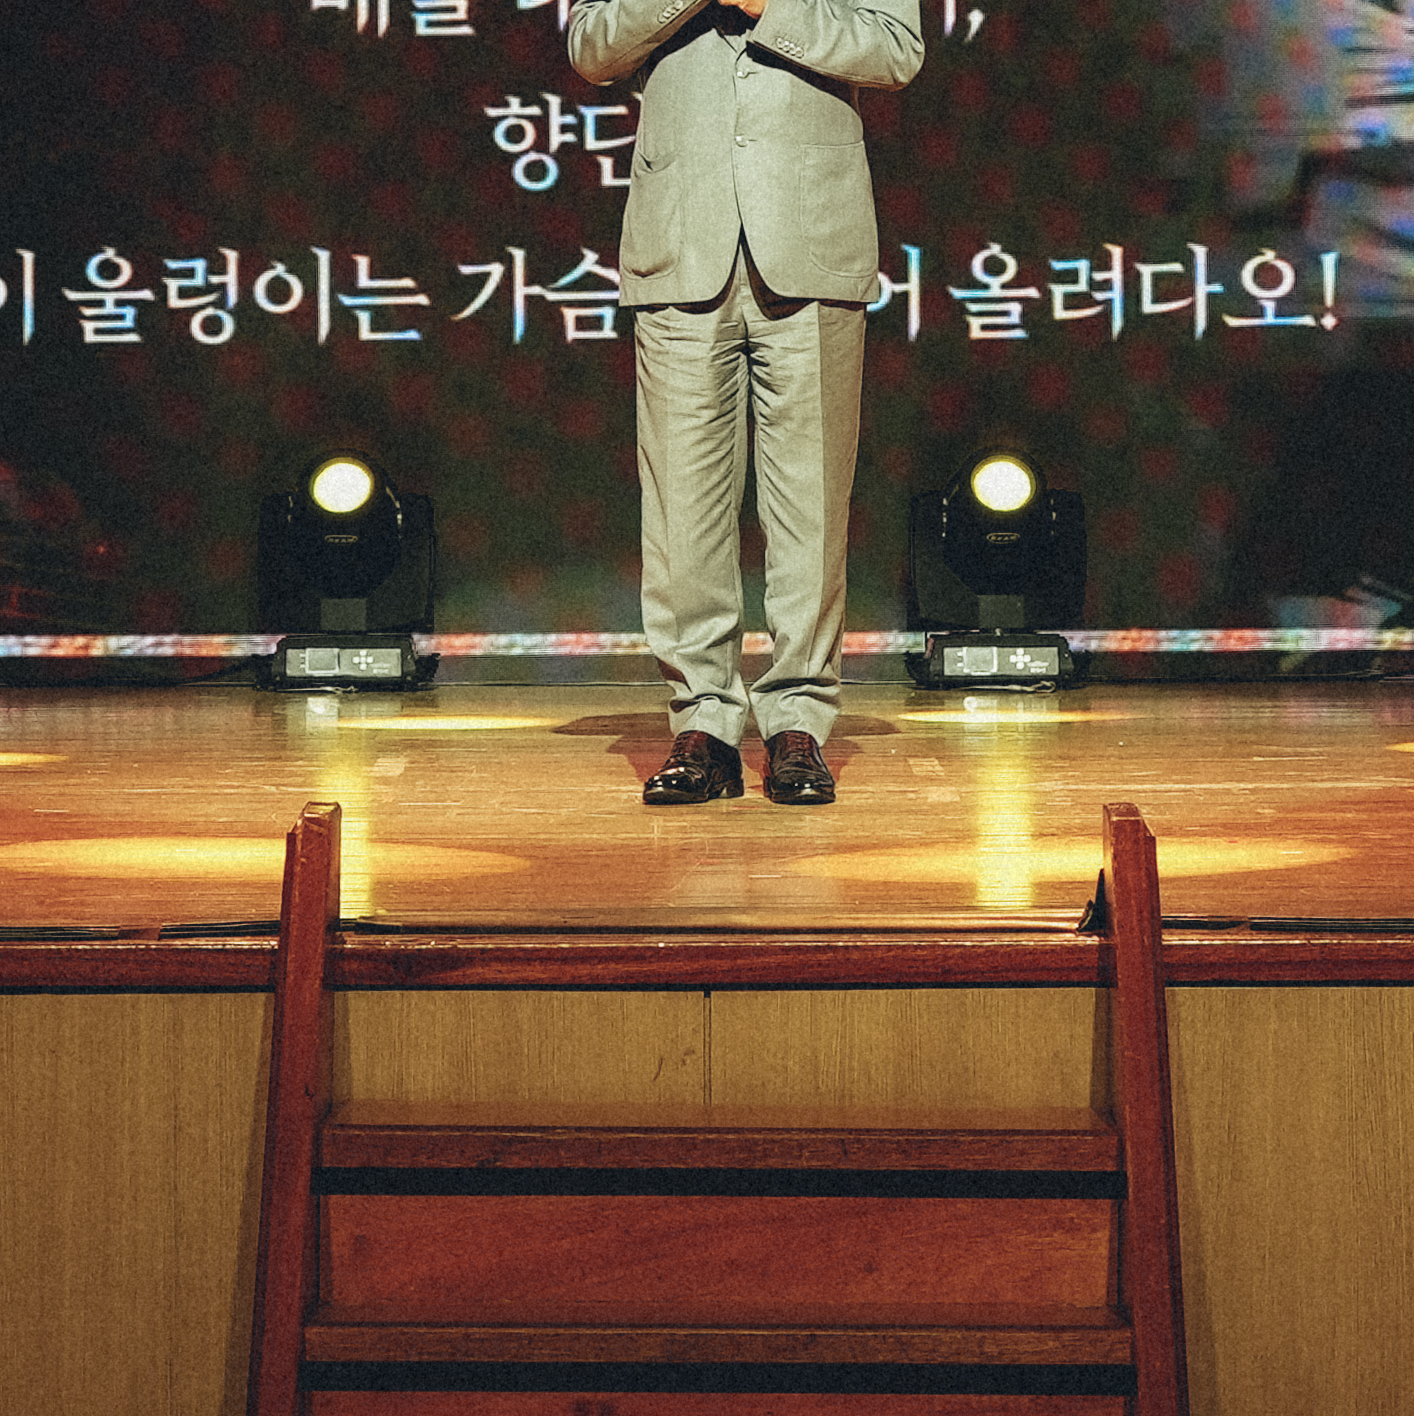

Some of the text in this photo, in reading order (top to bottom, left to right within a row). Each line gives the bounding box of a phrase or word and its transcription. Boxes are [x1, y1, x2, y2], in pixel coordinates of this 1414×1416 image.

[62, 246, 431, 346] 울렁이는
[450, 245, 620, 344] 가슴
[947, 242, 1341, 342] 올려다오!
